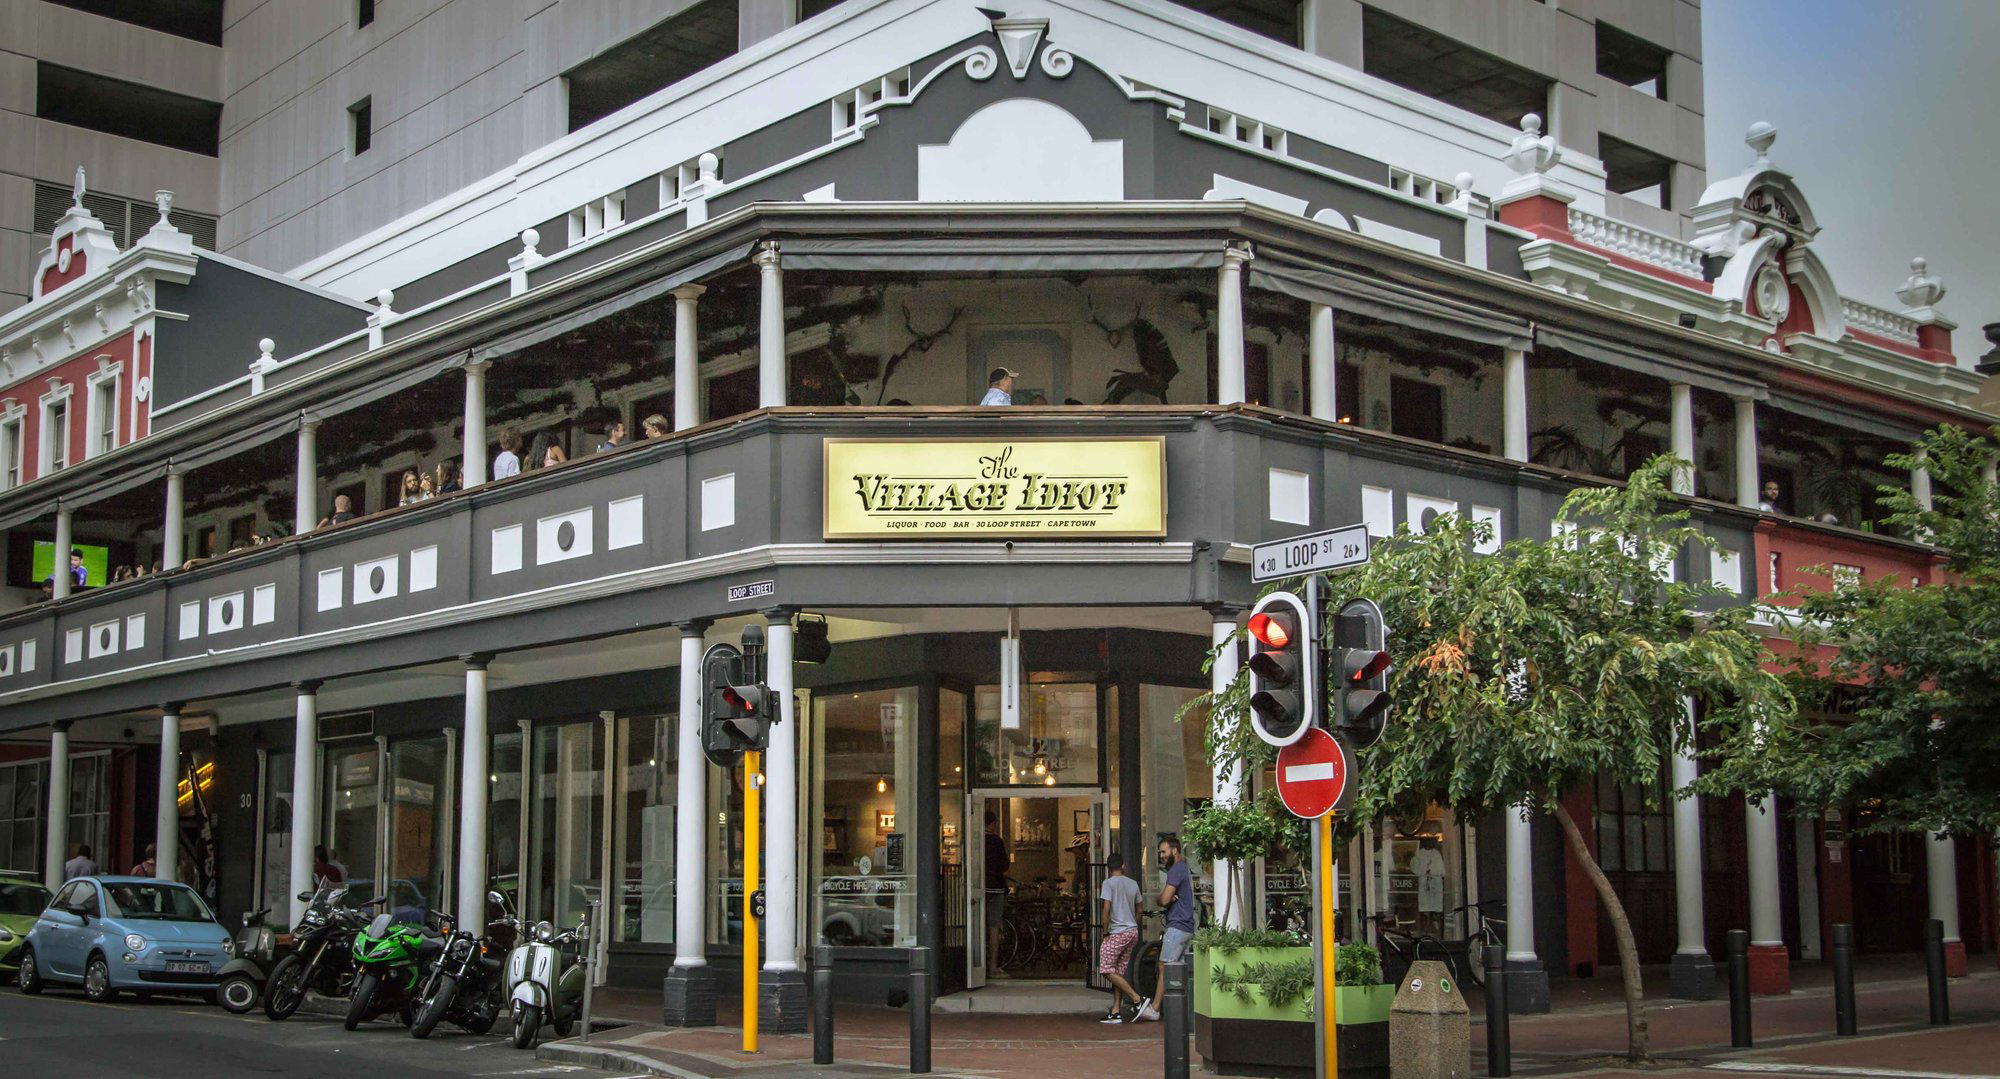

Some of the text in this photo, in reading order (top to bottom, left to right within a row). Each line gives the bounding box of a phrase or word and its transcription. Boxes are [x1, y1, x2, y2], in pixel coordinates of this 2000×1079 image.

[978, 446, 1020, 479] The
[852, 472, 1128, 511] VILLAGE IDIOT
[886, 521, 918, 529] LIQUOR
[1009, 520, 1041, 528] STREET
[1266, 539, 1353, 572] 30 LOOP ST 26
[730, 582, 772, 599] LOOP STREET
[240, 793, 252, 808] 30
[824, 880, 907, 890] BICYCLE HIRE PASTRIES
[1267, 879, 1291, 889] CYCLE
[1392, 879, 1413, 889] TOURS
